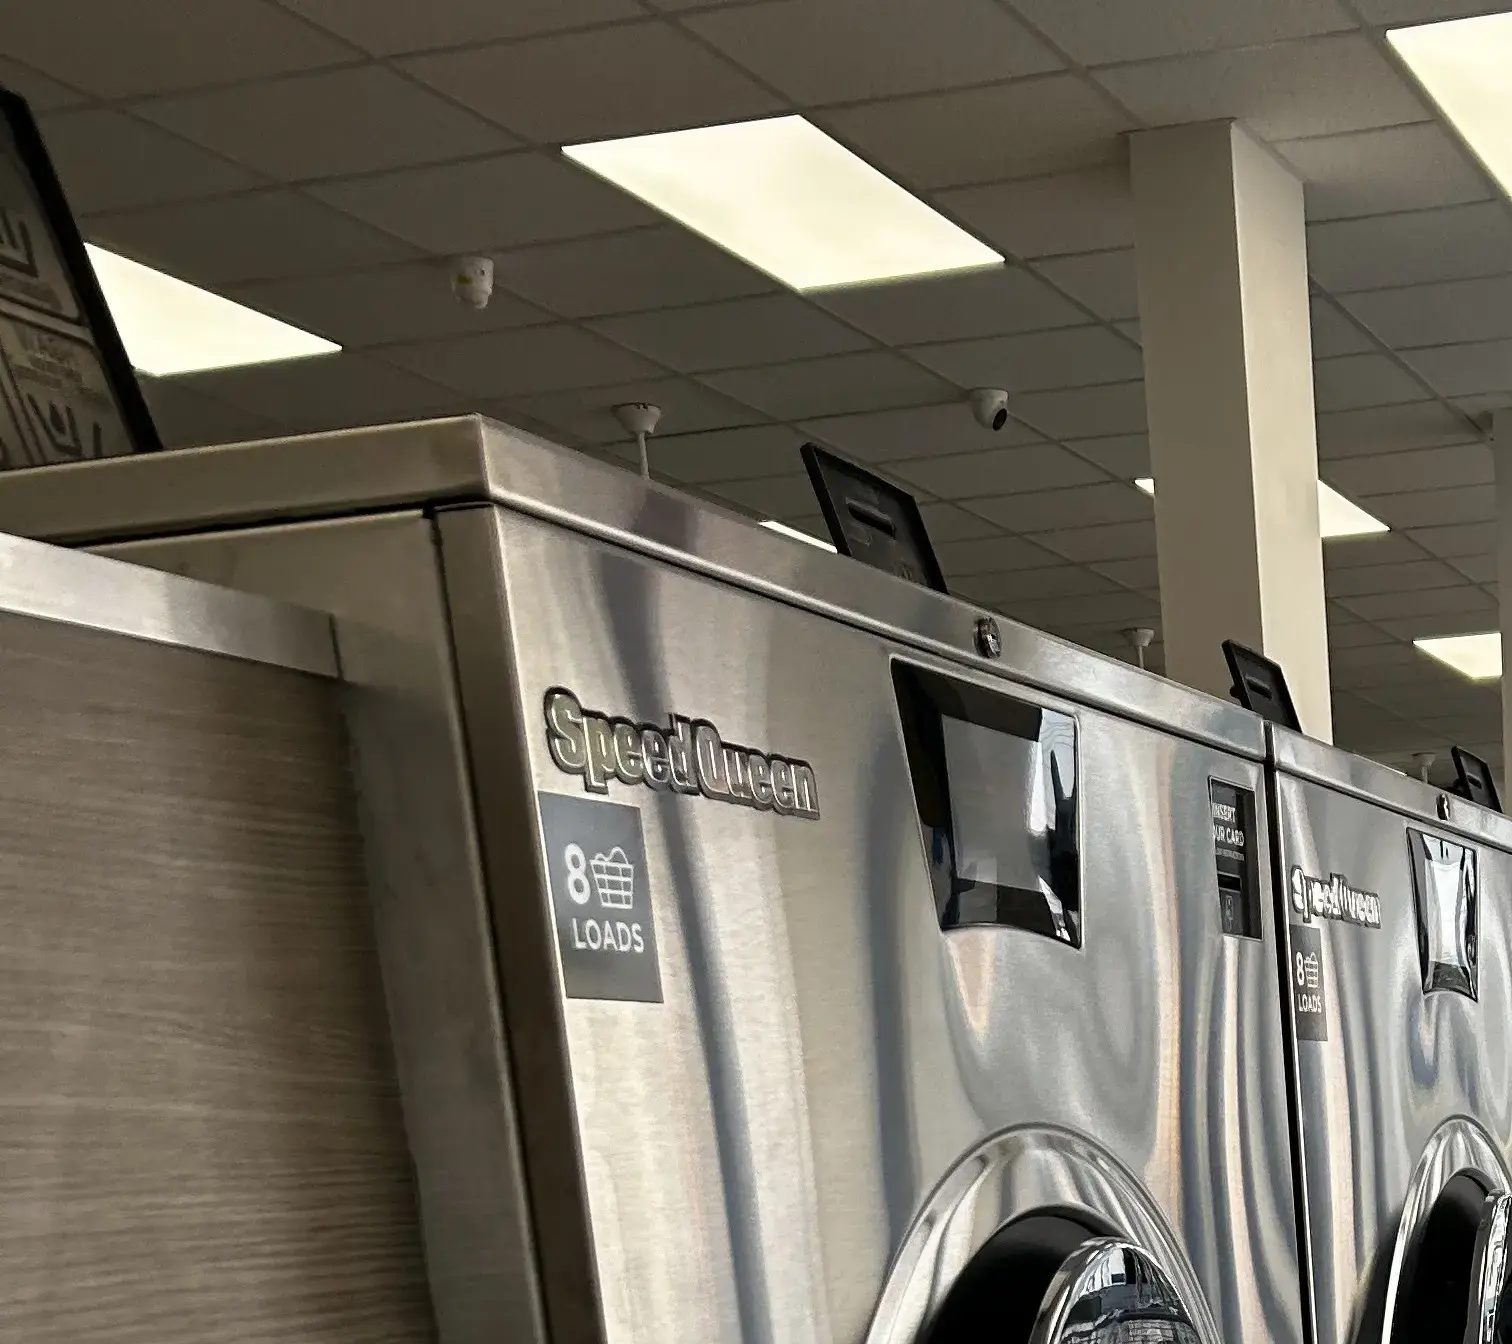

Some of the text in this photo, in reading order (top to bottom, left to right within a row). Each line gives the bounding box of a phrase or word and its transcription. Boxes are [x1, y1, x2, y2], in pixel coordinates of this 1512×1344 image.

[1212, 825, 1245, 847] OUR CARD
[564, 843, 592, 905] 8
[571, 916, 646, 954] LOADS
[1296, 951, 1305, 986] 8
[1298, 993, 1322, 1014] LOADS
